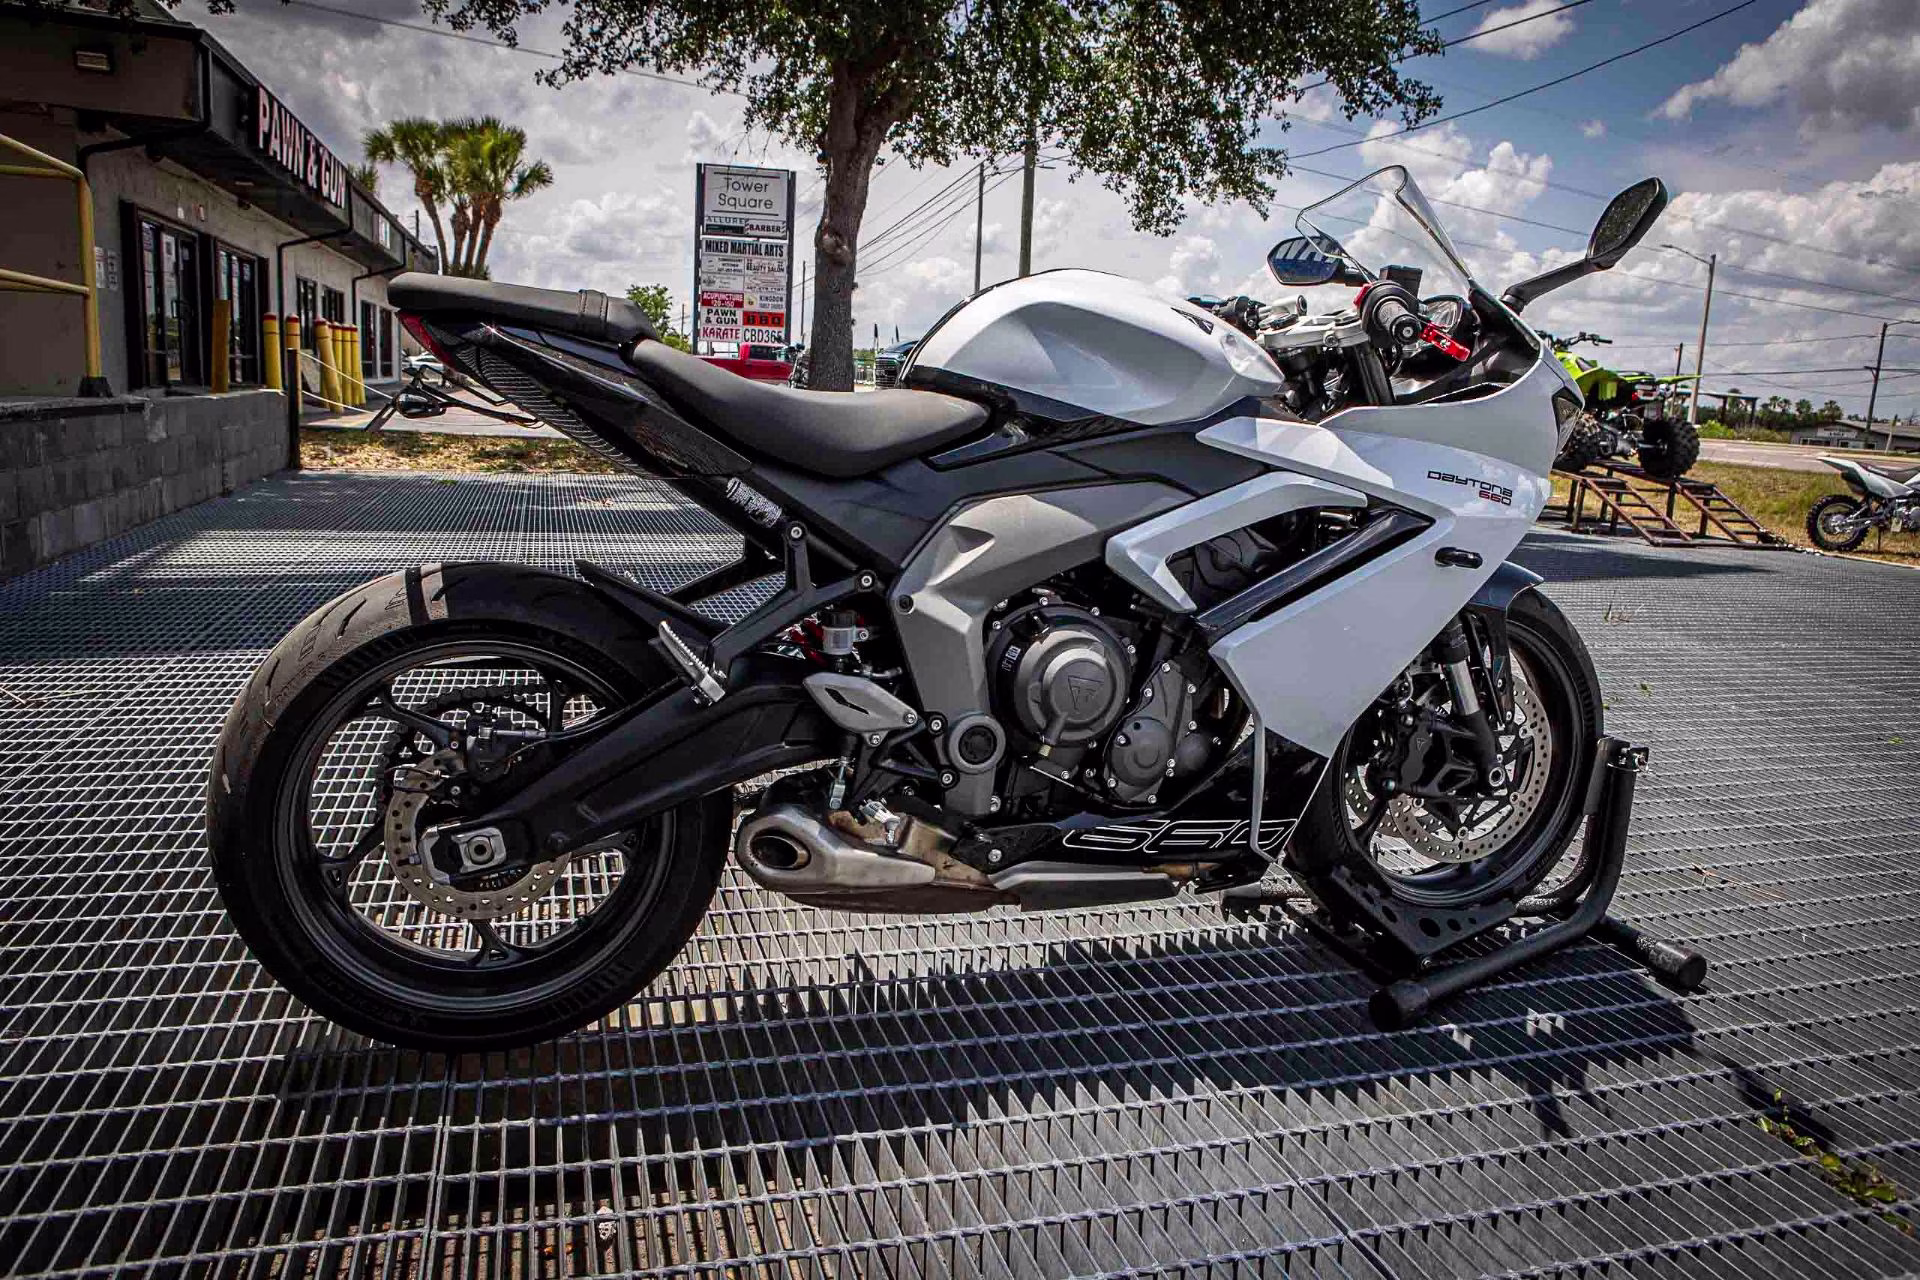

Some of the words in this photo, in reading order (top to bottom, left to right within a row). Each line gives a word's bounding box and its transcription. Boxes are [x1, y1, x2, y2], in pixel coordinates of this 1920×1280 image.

[258, 86, 305, 180] PAWN
[306, 135, 317, 189] &
[320, 148, 347, 209] GUN
[723, 177, 769, 193] Tower
[718, 193, 773, 210] Square
[749, 223, 782, 233] BARBER
[705, 240, 729, 254] MIXED
[730, 241, 762, 256] MARTIAL
[763, 244, 784, 258] ARTS
[707, 308, 737, 317] PAWN
[715, 317, 738, 325] GUN
[702, 327, 740, 340] KARATE
[1479, 489, 1512, 506] 660
